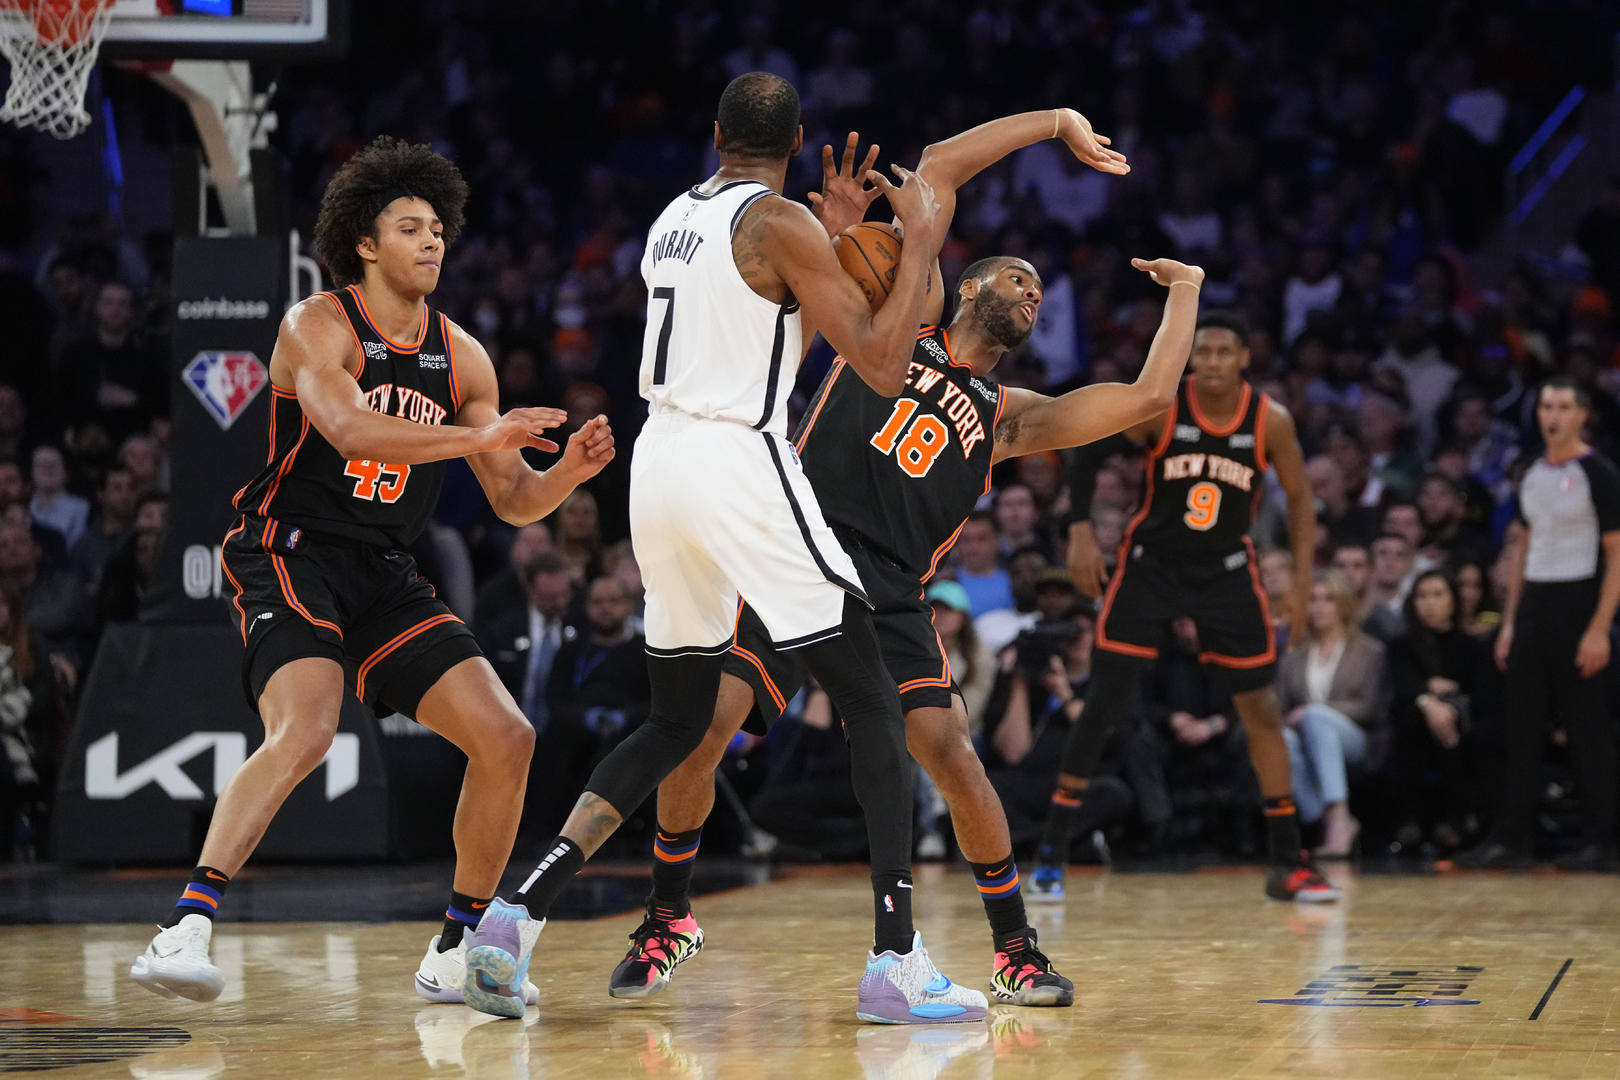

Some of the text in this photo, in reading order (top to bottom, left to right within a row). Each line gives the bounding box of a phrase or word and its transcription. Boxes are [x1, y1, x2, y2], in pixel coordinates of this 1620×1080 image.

[652, 229, 704, 268] DURANT
[418, 353, 446, 362] SQUARE
[652, 287, 675, 385] 7
[419, 361, 441, 370] SPACE
[396, 385, 447, 426] YORK
[905, 361, 986, 460] EW YORK
[869, 398, 949, 478] 18
[343, 459, 412, 504] 45
[1163, 453, 1255, 492] NEW YORK
[1183, 481, 1222, 531] 9
